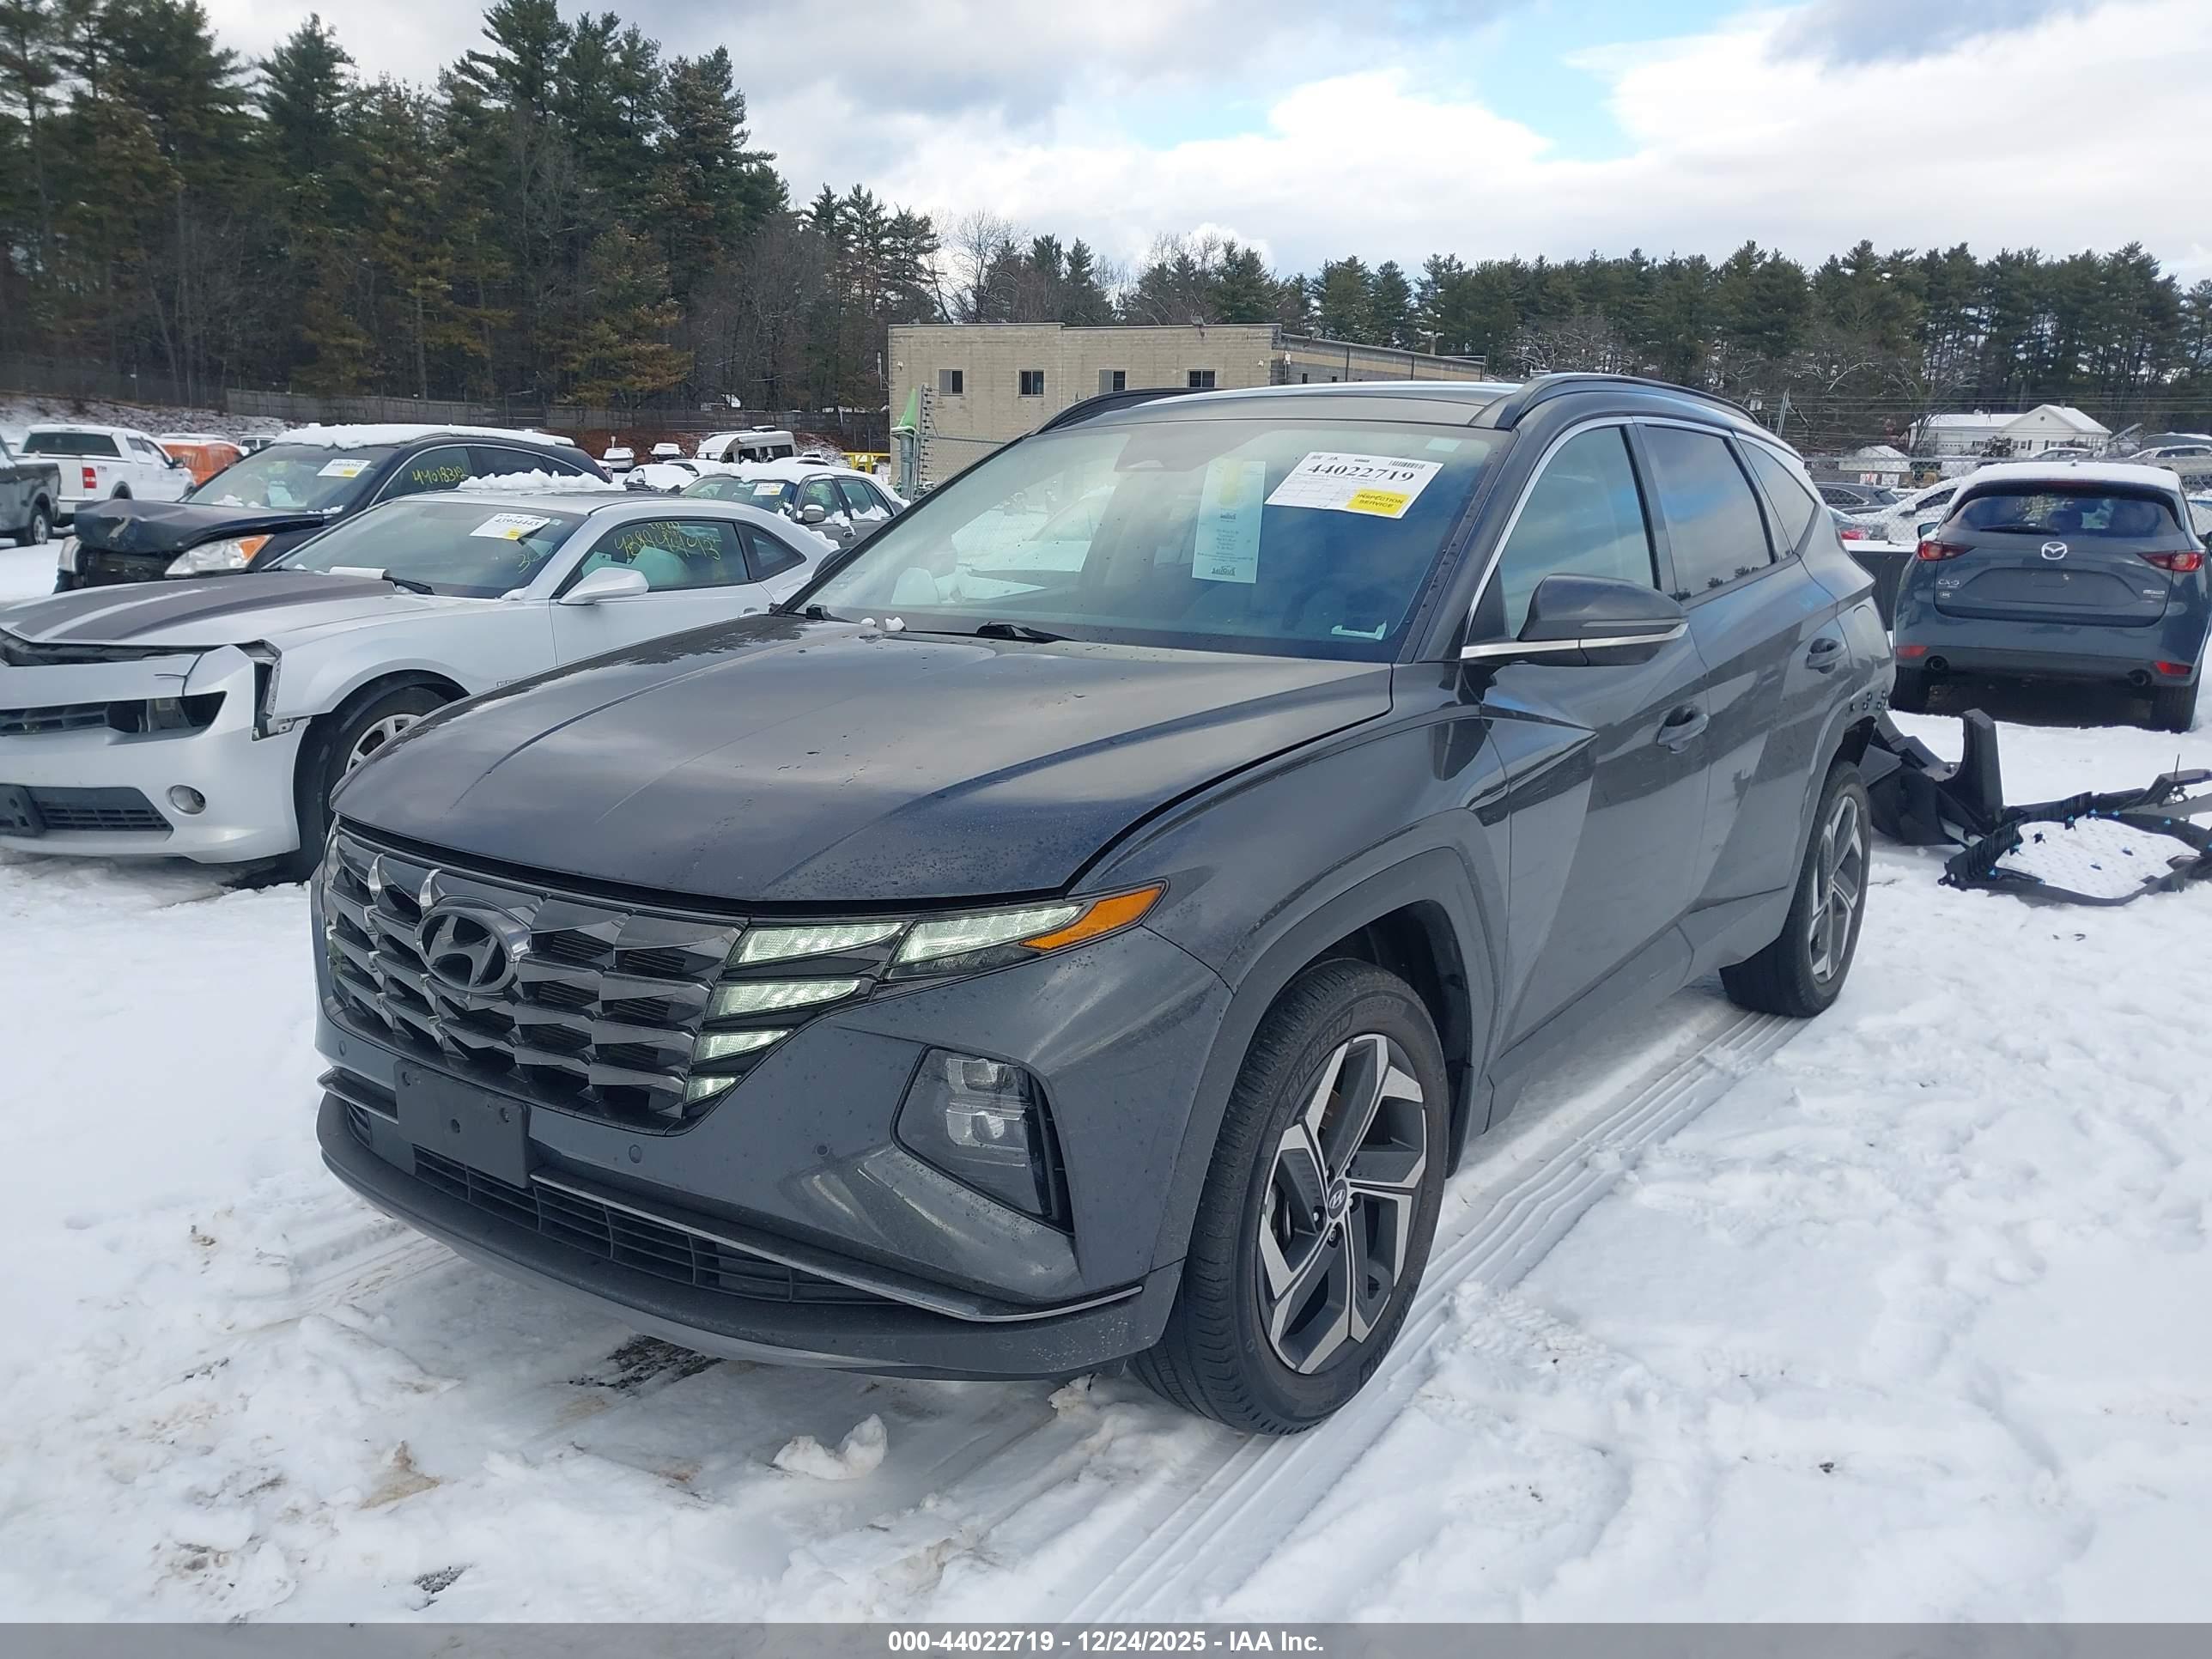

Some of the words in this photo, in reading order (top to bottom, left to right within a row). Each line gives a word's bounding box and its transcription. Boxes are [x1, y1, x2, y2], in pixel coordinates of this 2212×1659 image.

[412, 466, 469, 485] 44018312
[1307, 464, 1415, 482] 44022719
[1358, 494, 1404, 504] INSPECTION
[1359, 500, 1394, 508] SERVICE
